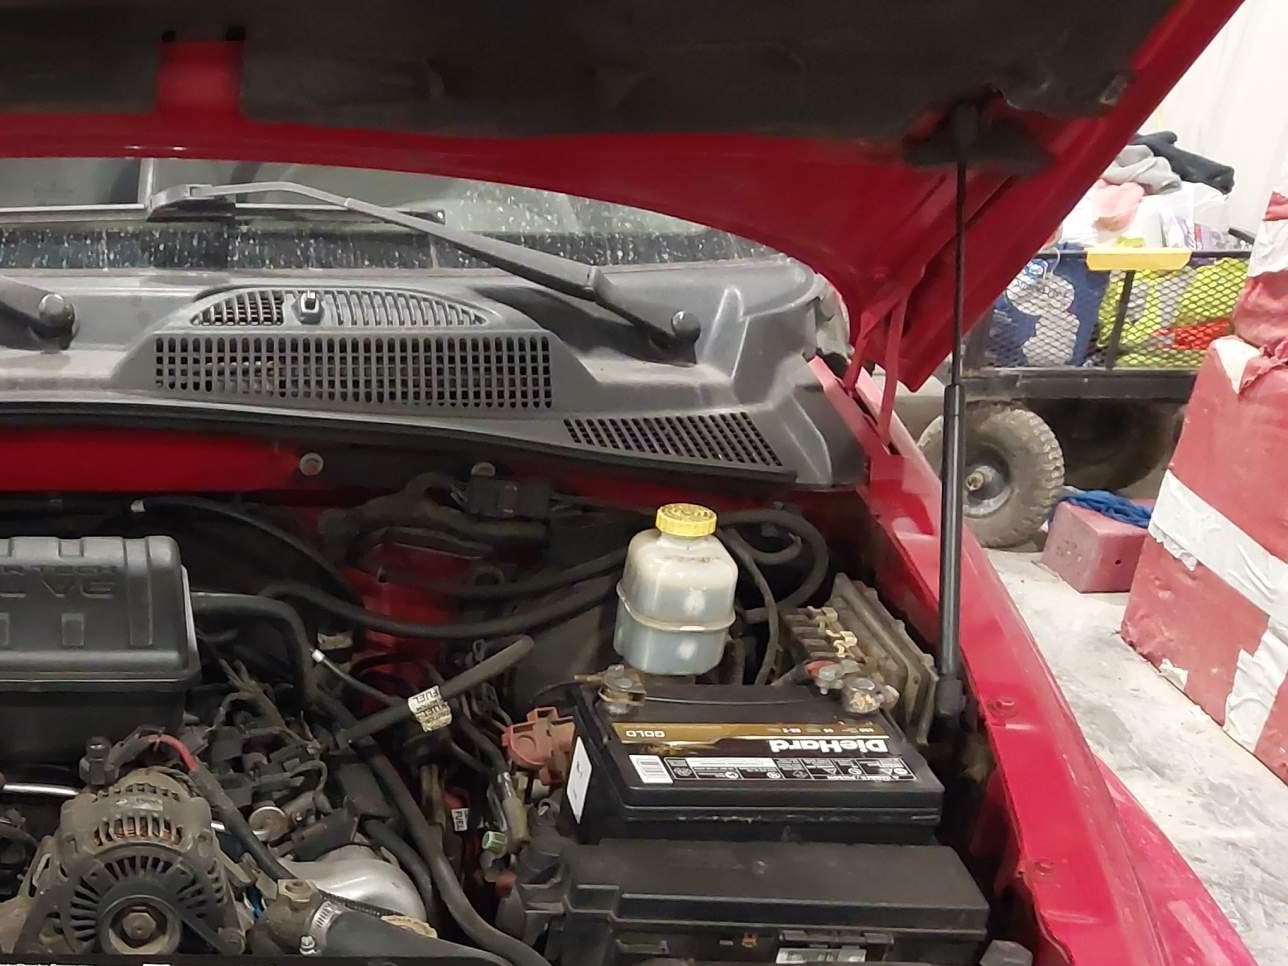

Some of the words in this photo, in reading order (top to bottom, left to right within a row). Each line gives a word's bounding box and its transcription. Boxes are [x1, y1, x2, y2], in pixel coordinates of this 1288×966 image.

[413, 689, 439, 704] FUEL
[626, 730, 665, 738] GOLD
[769, 740, 889, 753] DieHard
[454, 811, 465, 830] FUEL
